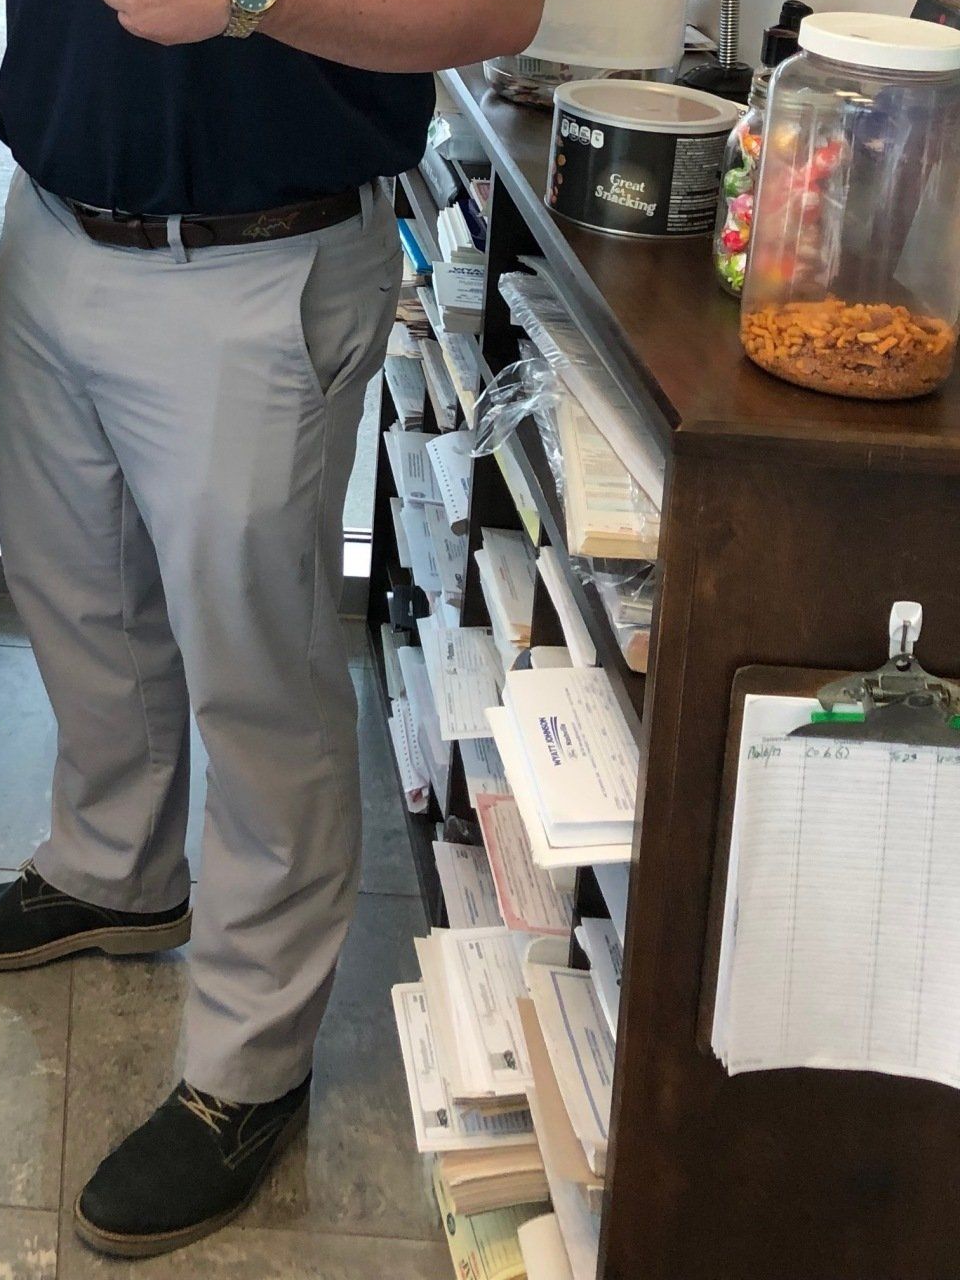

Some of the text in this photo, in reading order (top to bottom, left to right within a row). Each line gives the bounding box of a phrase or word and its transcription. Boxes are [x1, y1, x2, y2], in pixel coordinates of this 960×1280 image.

[610, 173, 646, 193] Great
[595, 185, 658, 217] Snacking
[539, 717, 561, 766] WYATT JOHNSON
